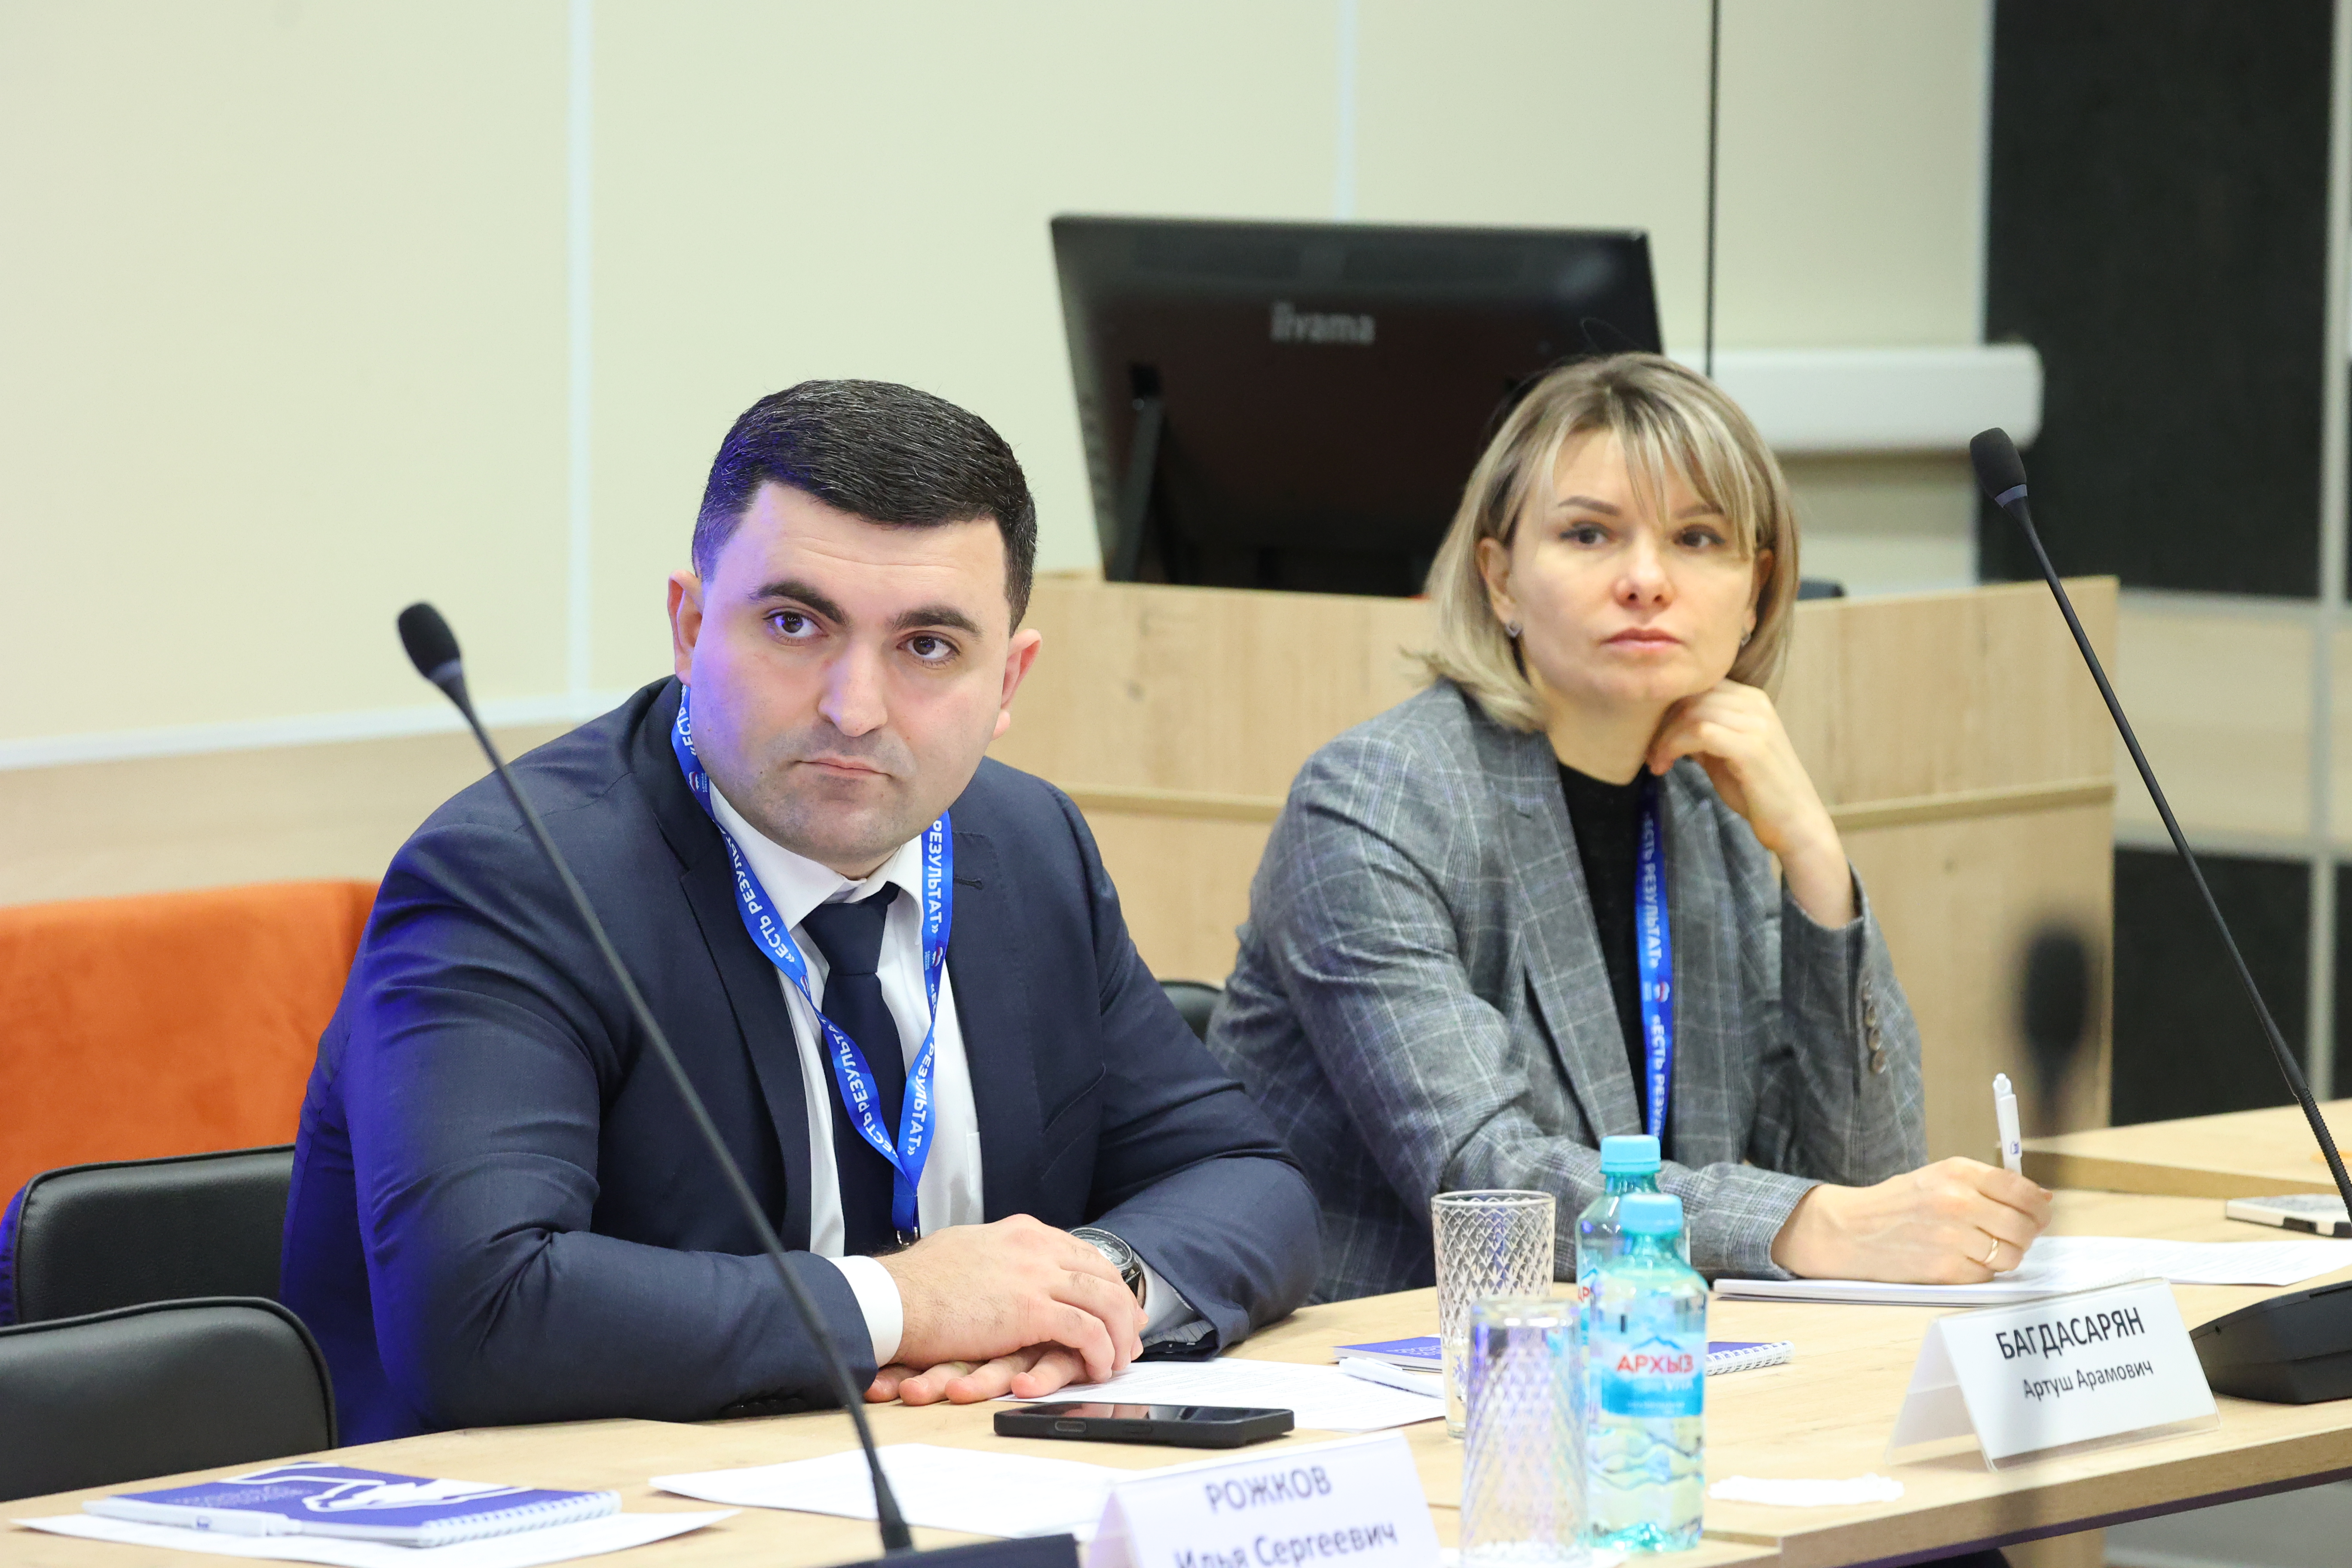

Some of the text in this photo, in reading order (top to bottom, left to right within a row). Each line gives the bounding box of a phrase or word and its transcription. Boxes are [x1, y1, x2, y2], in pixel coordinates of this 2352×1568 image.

[928, 820, 943, 934] РЕЗУЛЬТАТ»
[760, 915, 795, 962] «ЕСТЬ
[1651, 1014, 1666, 1070] «ЕСТЬ
[907, 1042, 934, 1156] РЕЗУЛЬТАТ»
[1995, 1306, 2146, 1361] БАГДАСАРЯН
[1617, 1354, 1694, 1374] АРХЫЗ
[2023, 1359, 2154, 1401] Артуш Арамович
[1205, 1465, 1332, 1514] РОЖКОВ
[1253, 1522, 1399, 1568] Сергеевич
